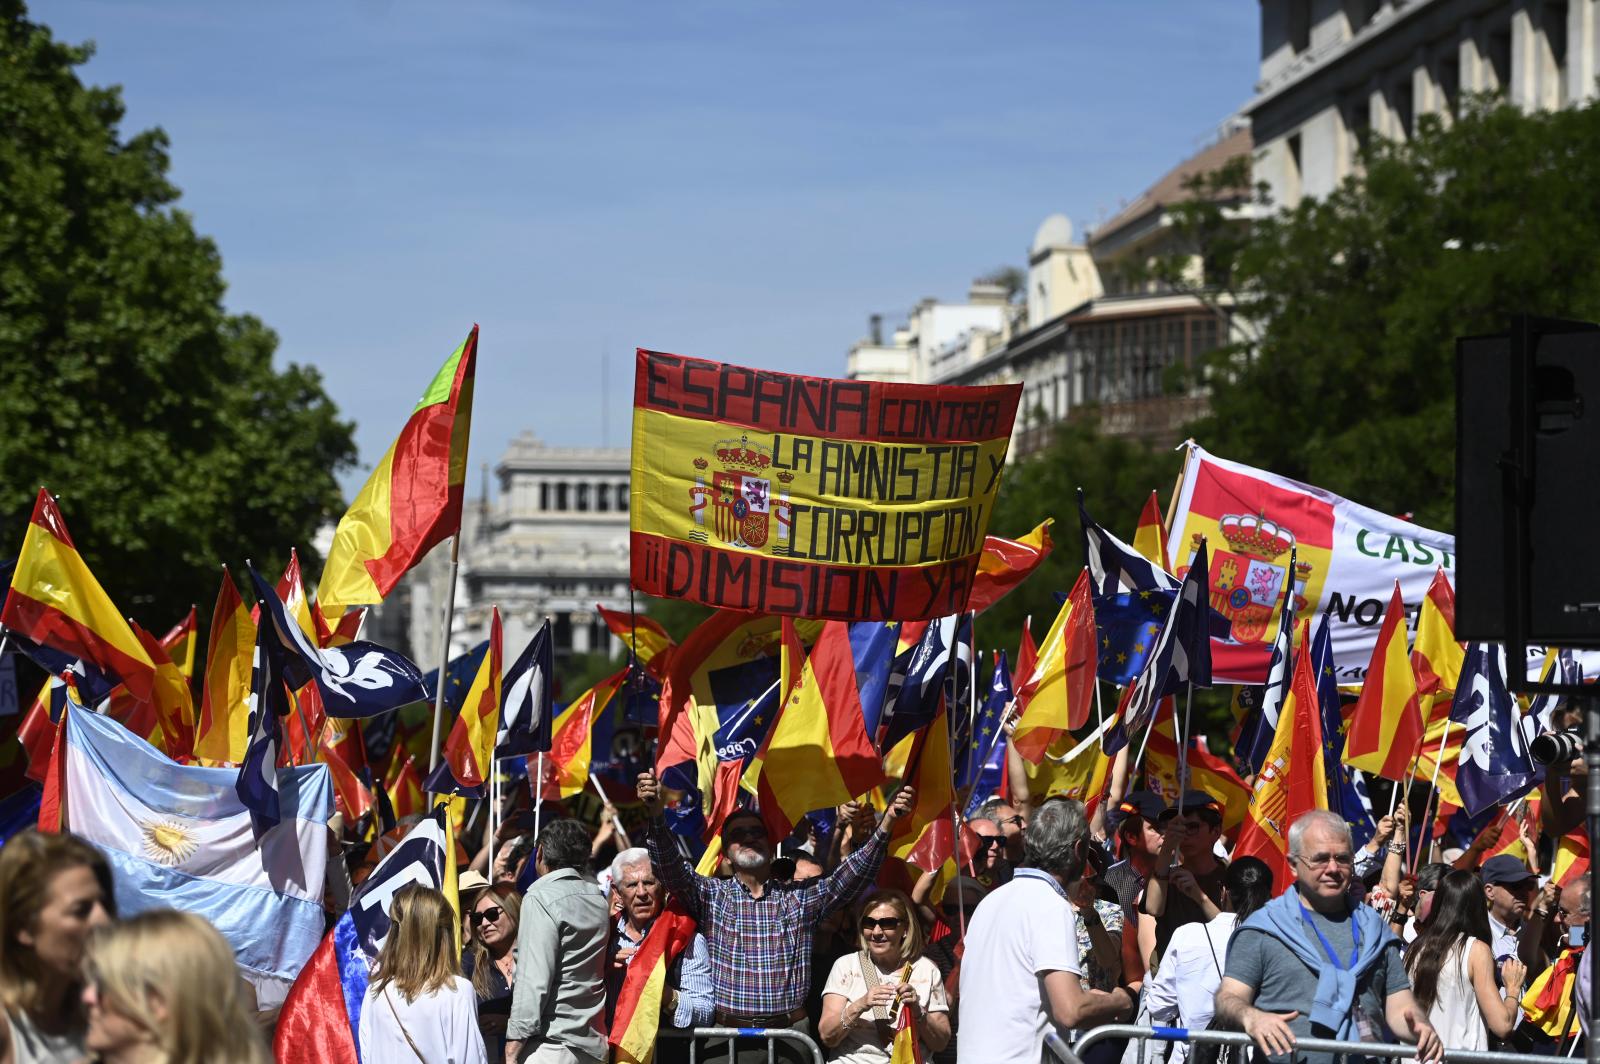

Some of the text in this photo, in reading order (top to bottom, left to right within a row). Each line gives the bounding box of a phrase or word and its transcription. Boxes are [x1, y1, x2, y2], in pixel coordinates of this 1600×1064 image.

[879, 398, 1000, 438] CONTRA
[771, 434, 1007, 501] LA AMNISTIA Y
[788, 503, 983, 565] CORRUPCION
[1326, 591, 1384, 626] NO
